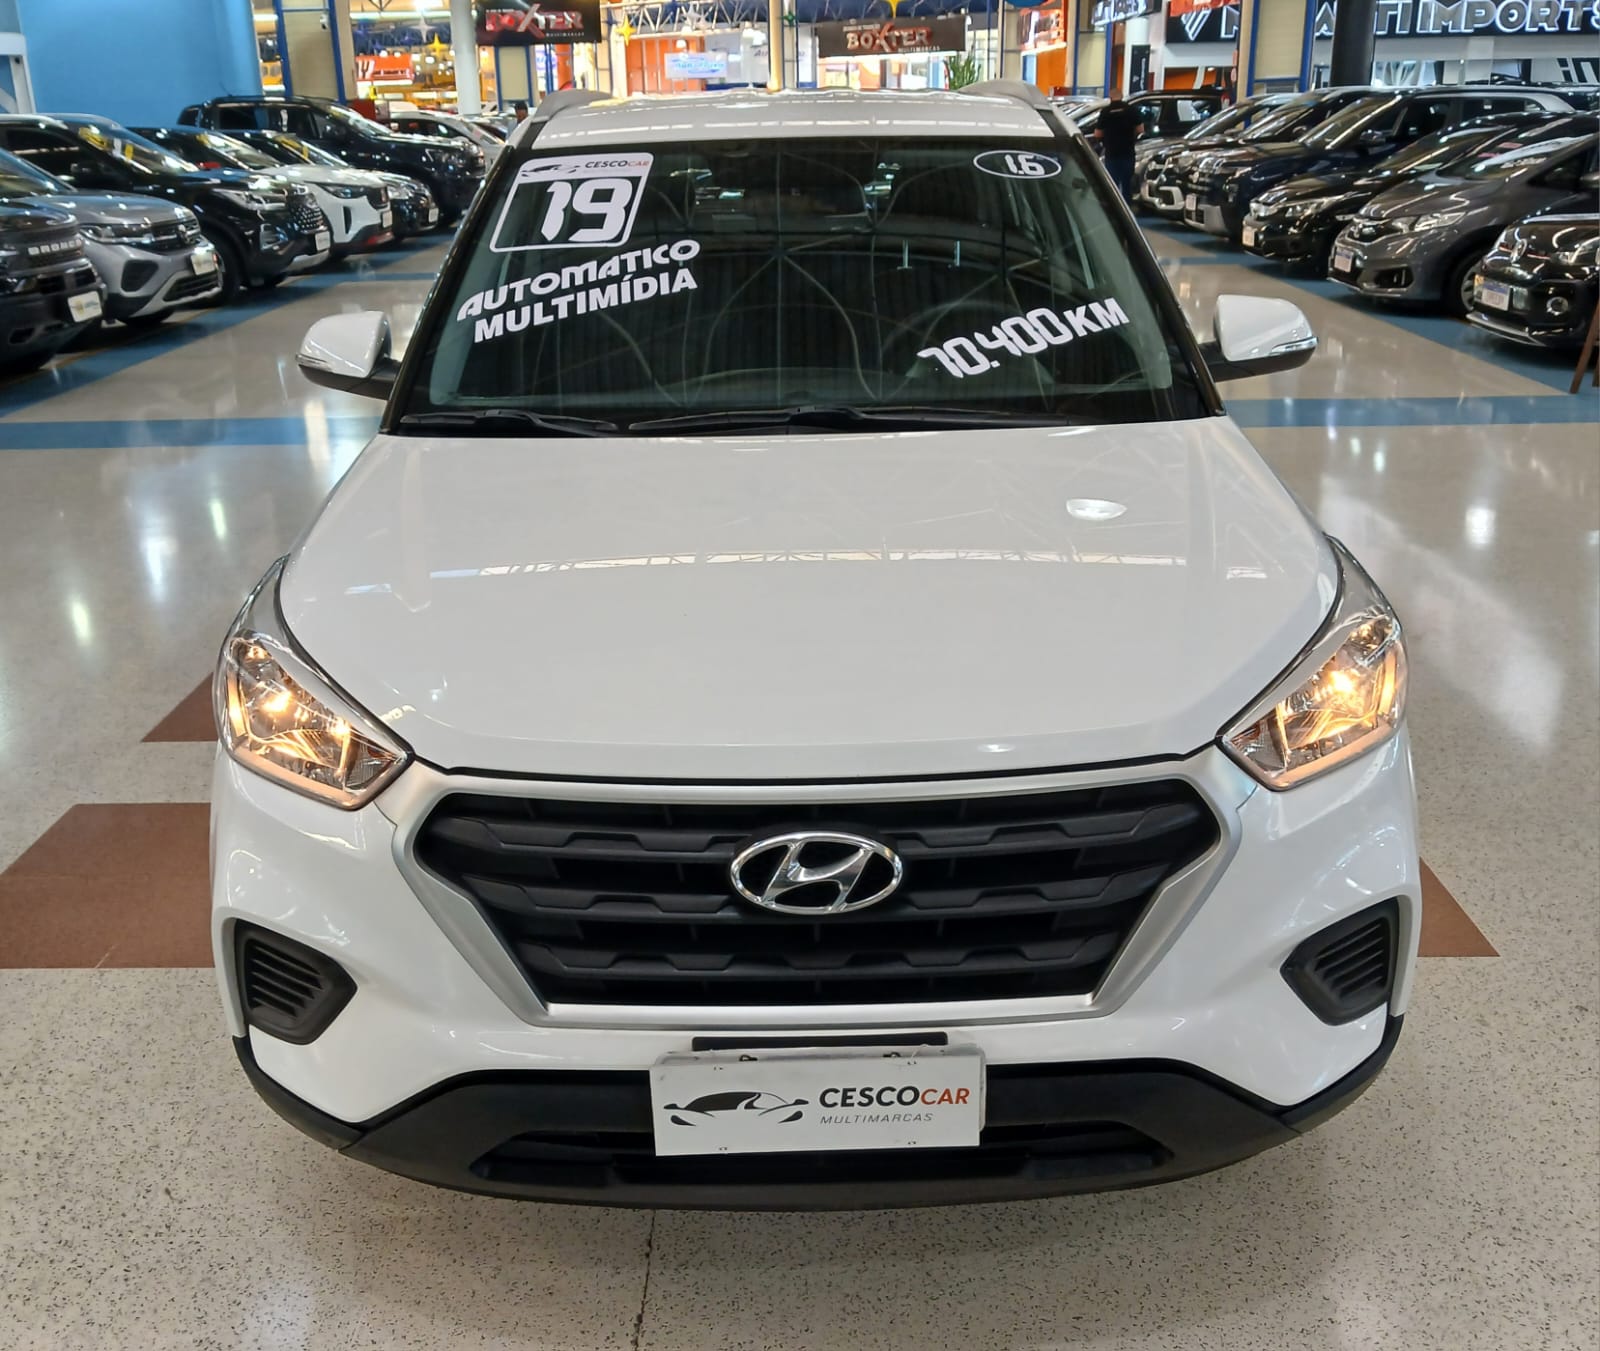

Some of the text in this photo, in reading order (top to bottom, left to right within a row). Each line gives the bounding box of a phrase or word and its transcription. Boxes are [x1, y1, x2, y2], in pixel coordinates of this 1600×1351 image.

[846, 22, 929, 53] BOXTER
[584, 160, 650, 169] CESCOCAR
[1004, 153, 1046, 176] 1.6
[540, 177, 633, 243] 19
[456, 239, 701, 322] AUTOMATICO
[474, 268, 698, 343] MULTIMÍDIA
[818, 1085, 971, 1109] CESCOCAR
[819, 1112, 935, 1125] MULTIMARCAS
